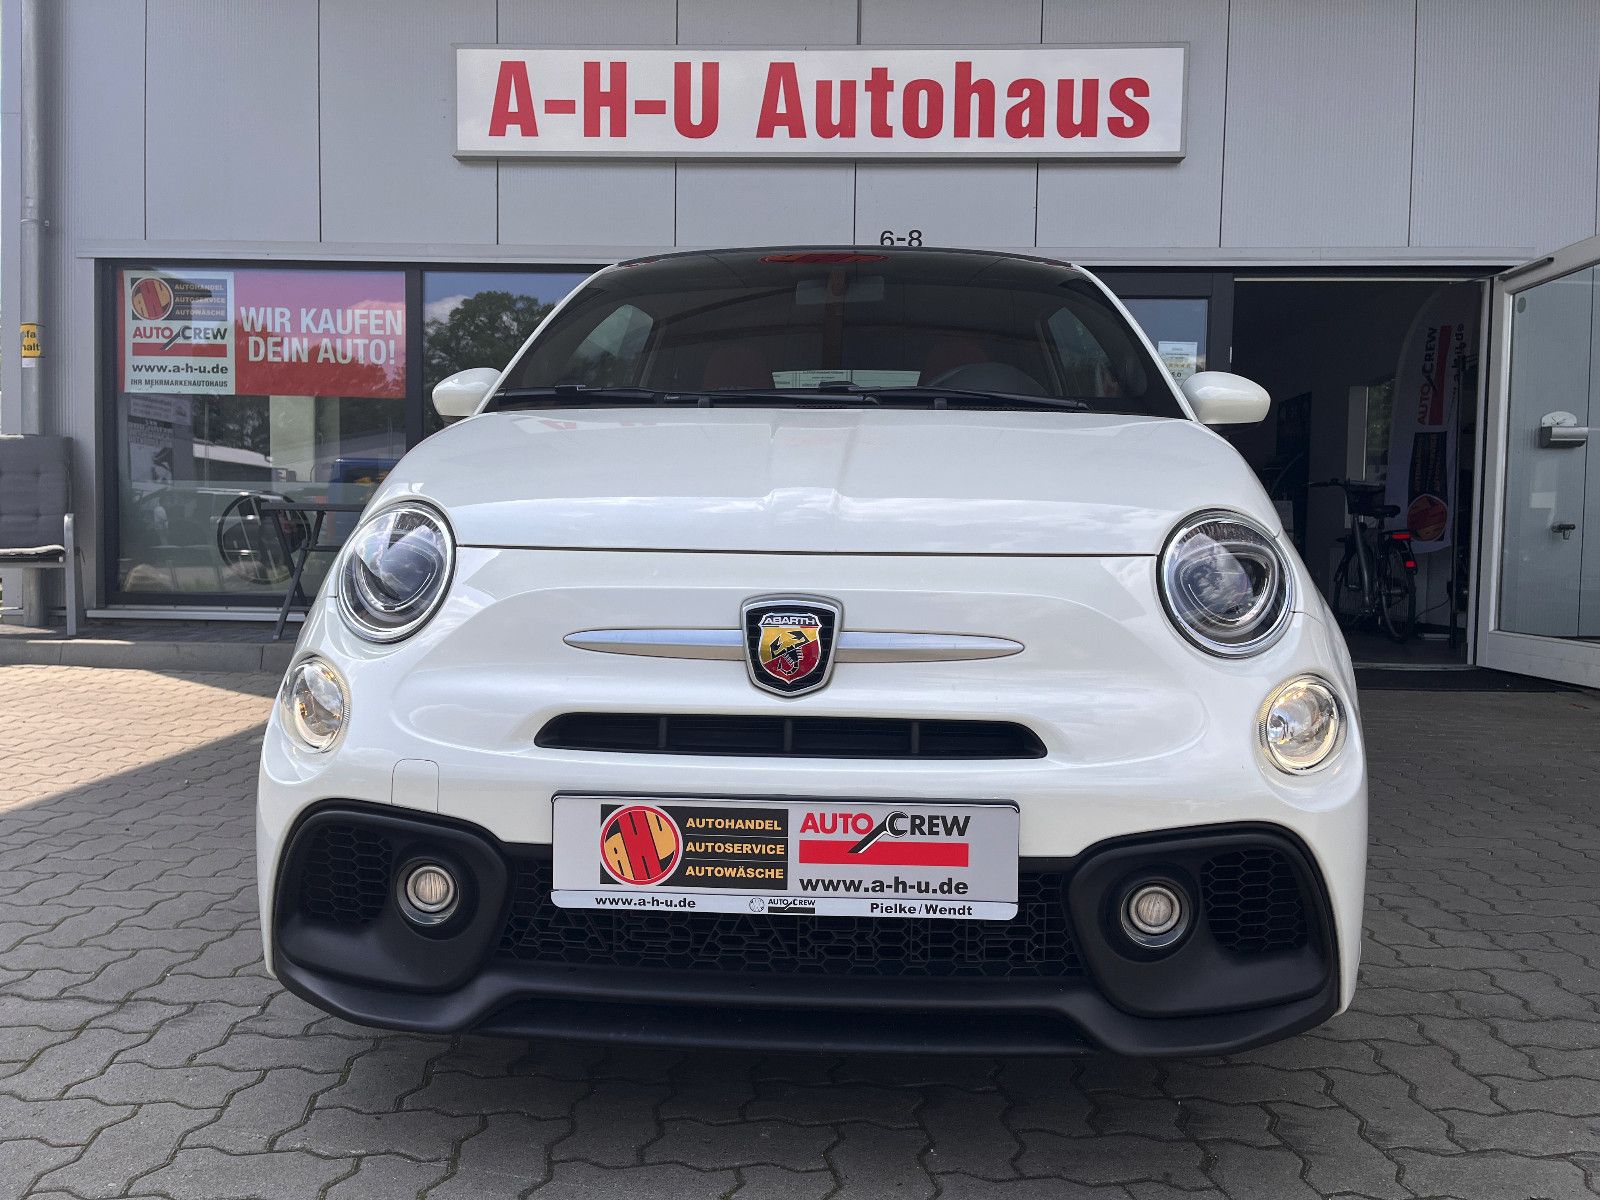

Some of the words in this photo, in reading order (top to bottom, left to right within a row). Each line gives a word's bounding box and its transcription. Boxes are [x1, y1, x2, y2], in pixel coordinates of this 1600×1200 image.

[487, 60, 720, 138] A-H-U
[755, 61, 1151, 139] Autohaus
[880, 229, 922, 247] 6-8
[239, 306, 292, 333] WIR
[300, 308, 403, 336] KAUFEN
[132, 326, 174, 340] AUTO
[180, 325, 228, 340] CREW
[248, 336, 309, 362] DEIN
[316, 338, 396, 365] AUTO!
[132, 363, 229, 374] www.a-h-u.de
[130, 378, 143, 386] IHR
[144, 379, 228, 388] MEHRMARKENAUTOHAUS
[764, 616, 815, 625] ABARTH
[685, 817, 782, 831] AUTOHANDEL
[799, 812, 874, 835] AUTO
[887, 811, 971, 837] CREW
[685, 841, 785, 855] AUTOSERVICE
[685, 865, 784, 879] AUTOWÄSCHE
[799, 876, 969, 895] www.a-h-u.de
[594, 896, 697, 909] www.a-h-u.de
[767, 898, 788, 906] AUTO
